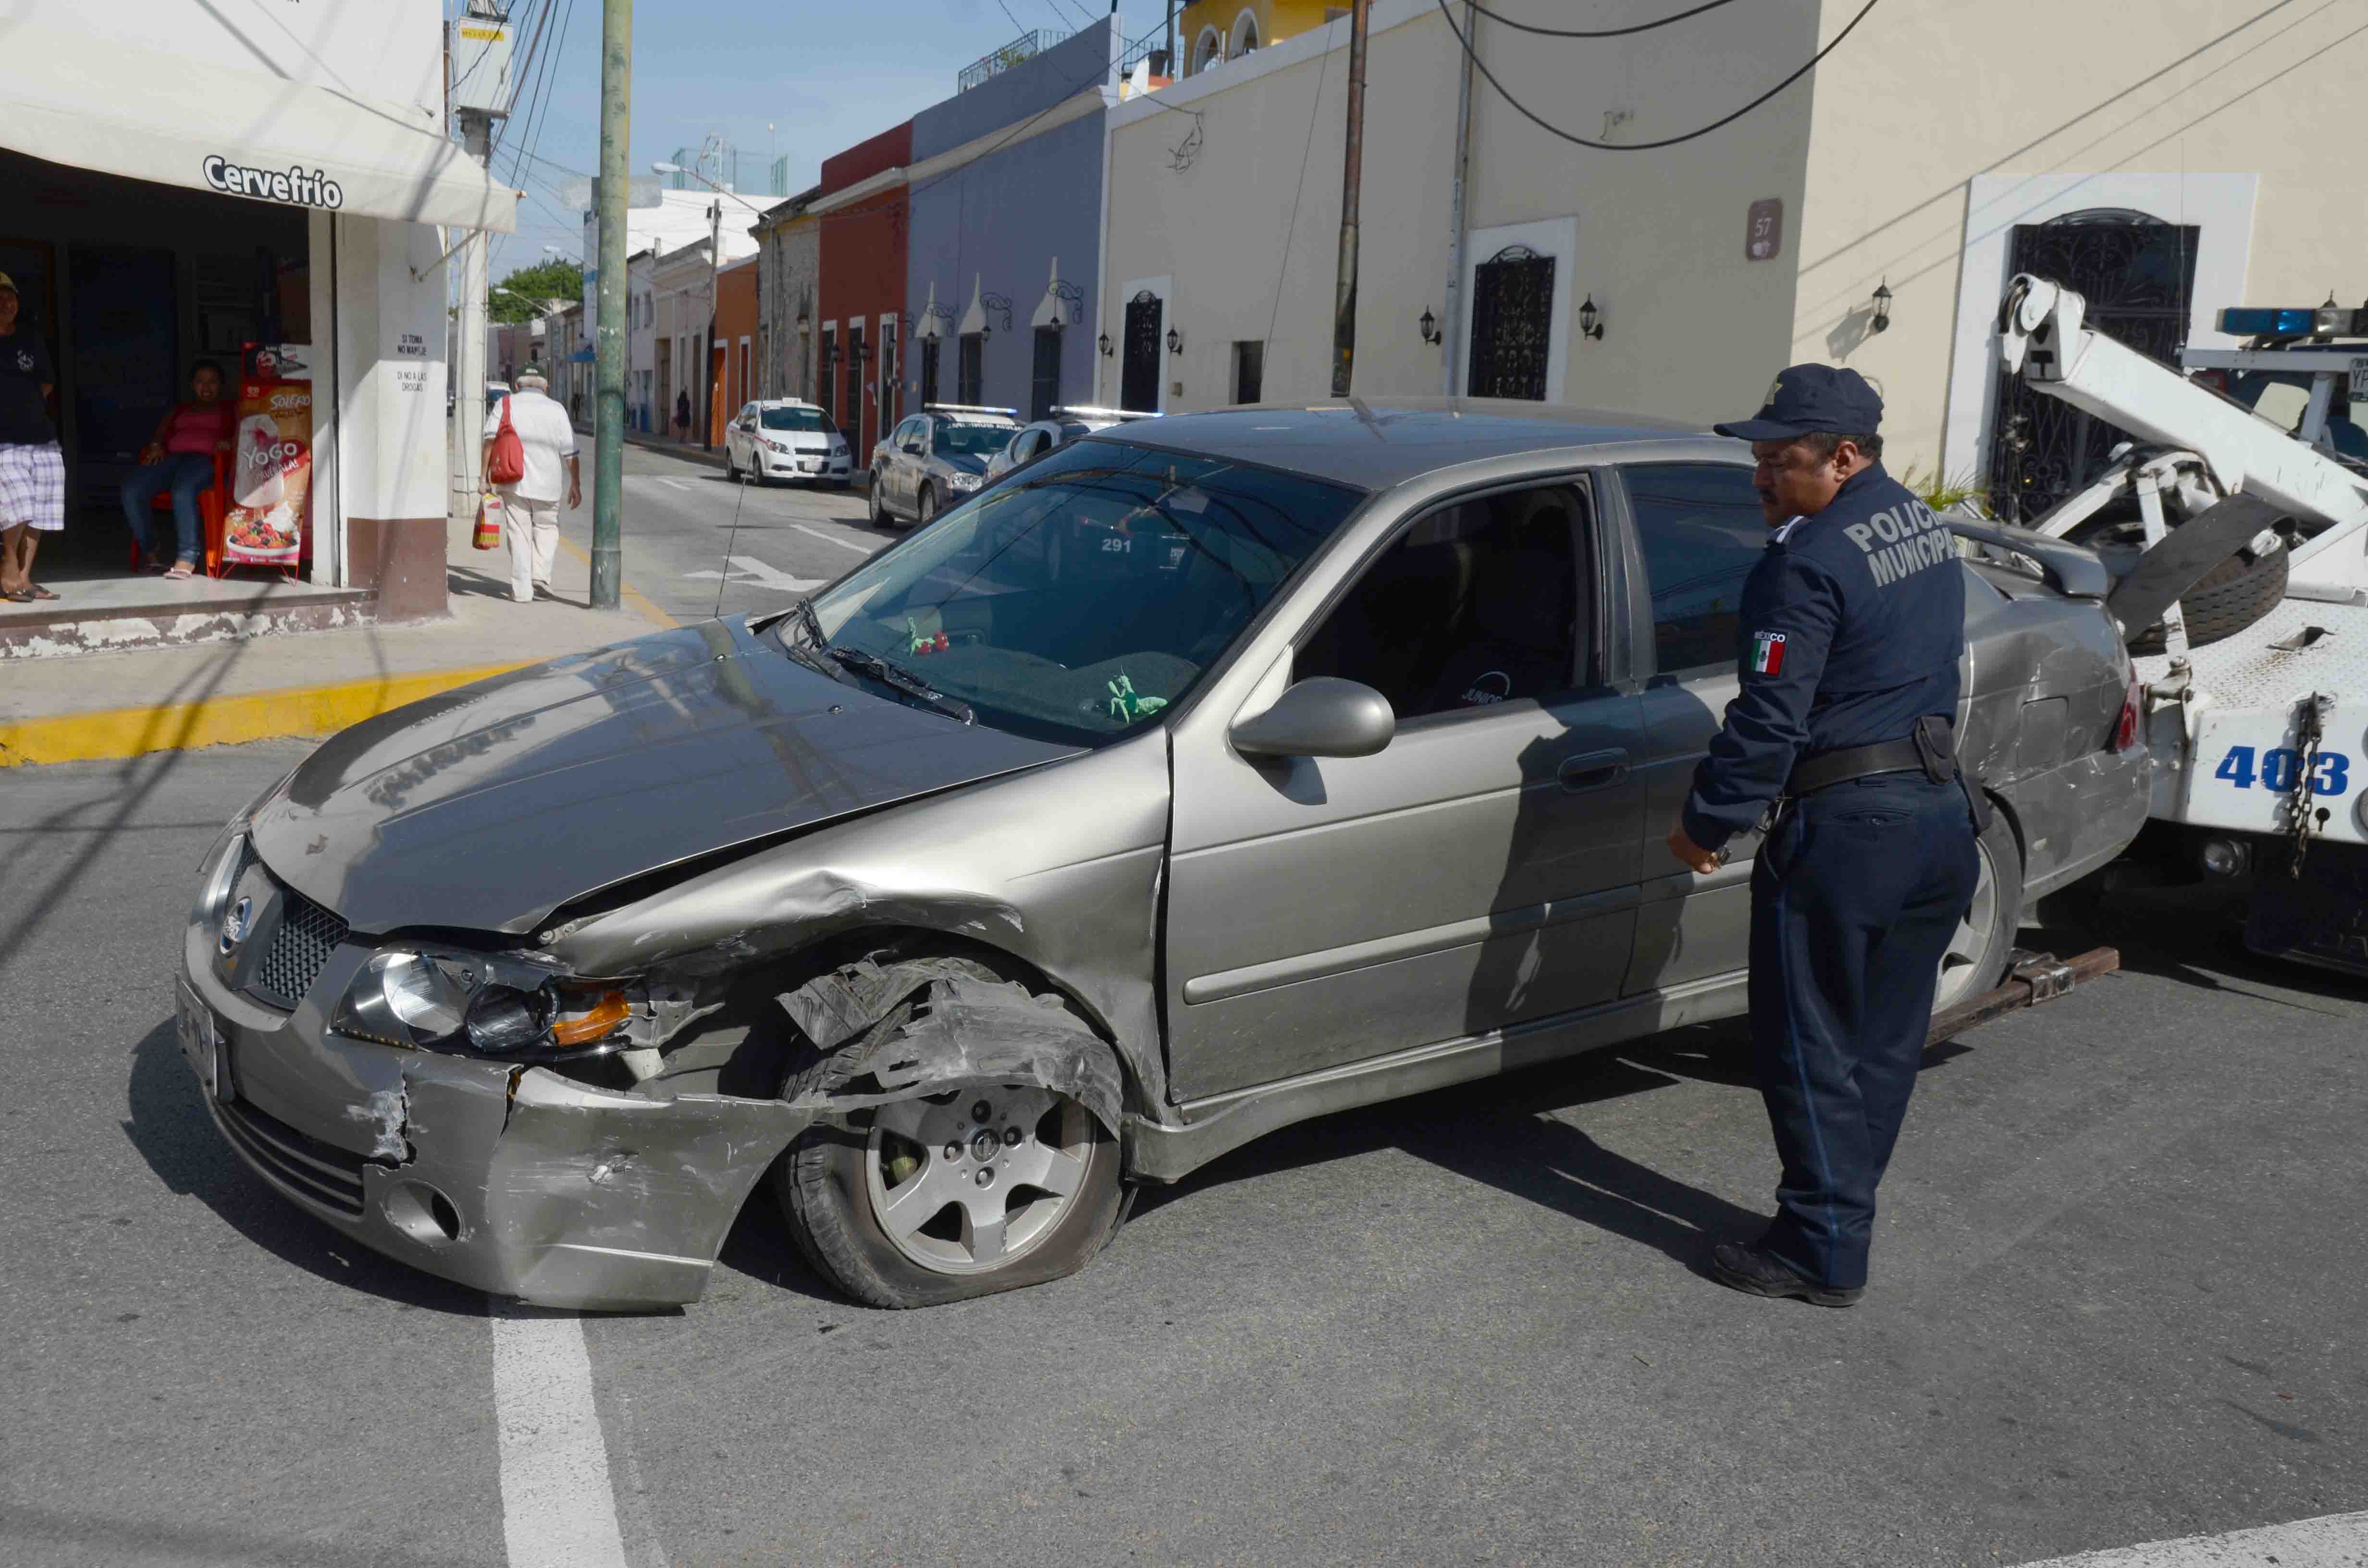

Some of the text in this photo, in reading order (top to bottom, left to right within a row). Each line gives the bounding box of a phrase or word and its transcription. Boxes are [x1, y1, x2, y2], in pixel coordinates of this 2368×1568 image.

[203, 155, 343, 209] Cervefrío
[1754, 217, 1772, 237] 57
[401, 334, 423, 343] SI TOMA
[397, 345, 406, 354] NO
[404, 372, 411, 380] NO
[418, 372, 427, 381] LAS
[401, 382, 423, 392] DROGAS
[270, 394, 311, 410] SOLERO
[242, 442, 297, 469] YOGO
[1101, 538, 1131, 553] 291
[2214, 745, 2350, 796] 403
